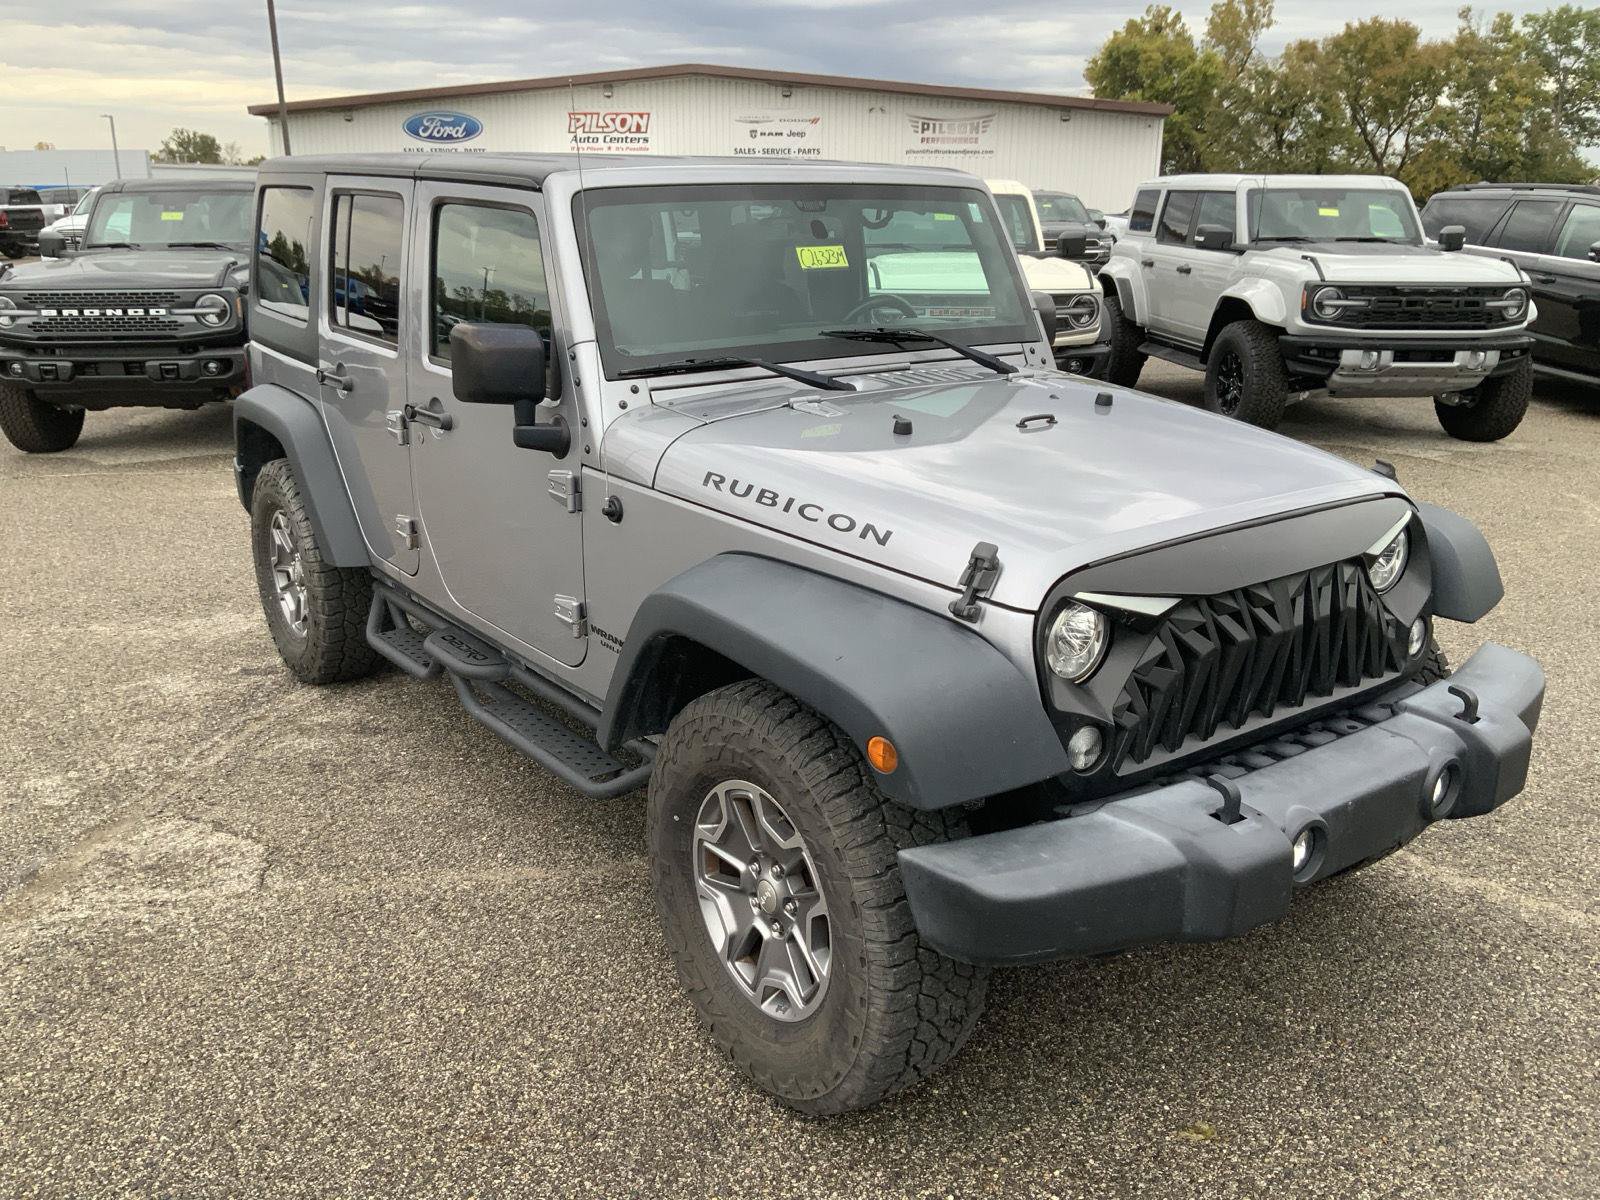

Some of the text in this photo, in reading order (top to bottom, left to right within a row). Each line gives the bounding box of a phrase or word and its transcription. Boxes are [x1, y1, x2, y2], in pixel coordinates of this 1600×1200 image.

[419, 116, 466, 138] Ford
[568, 112, 651, 133] PILSON
[921, 121, 980, 134] PILSON
[570, 135, 650, 143] Auto Centers
[786, 130, 806, 138] Jeep
[40, 308, 166, 317] BRONCO
[702, 471, 893, 547] RUBICON
